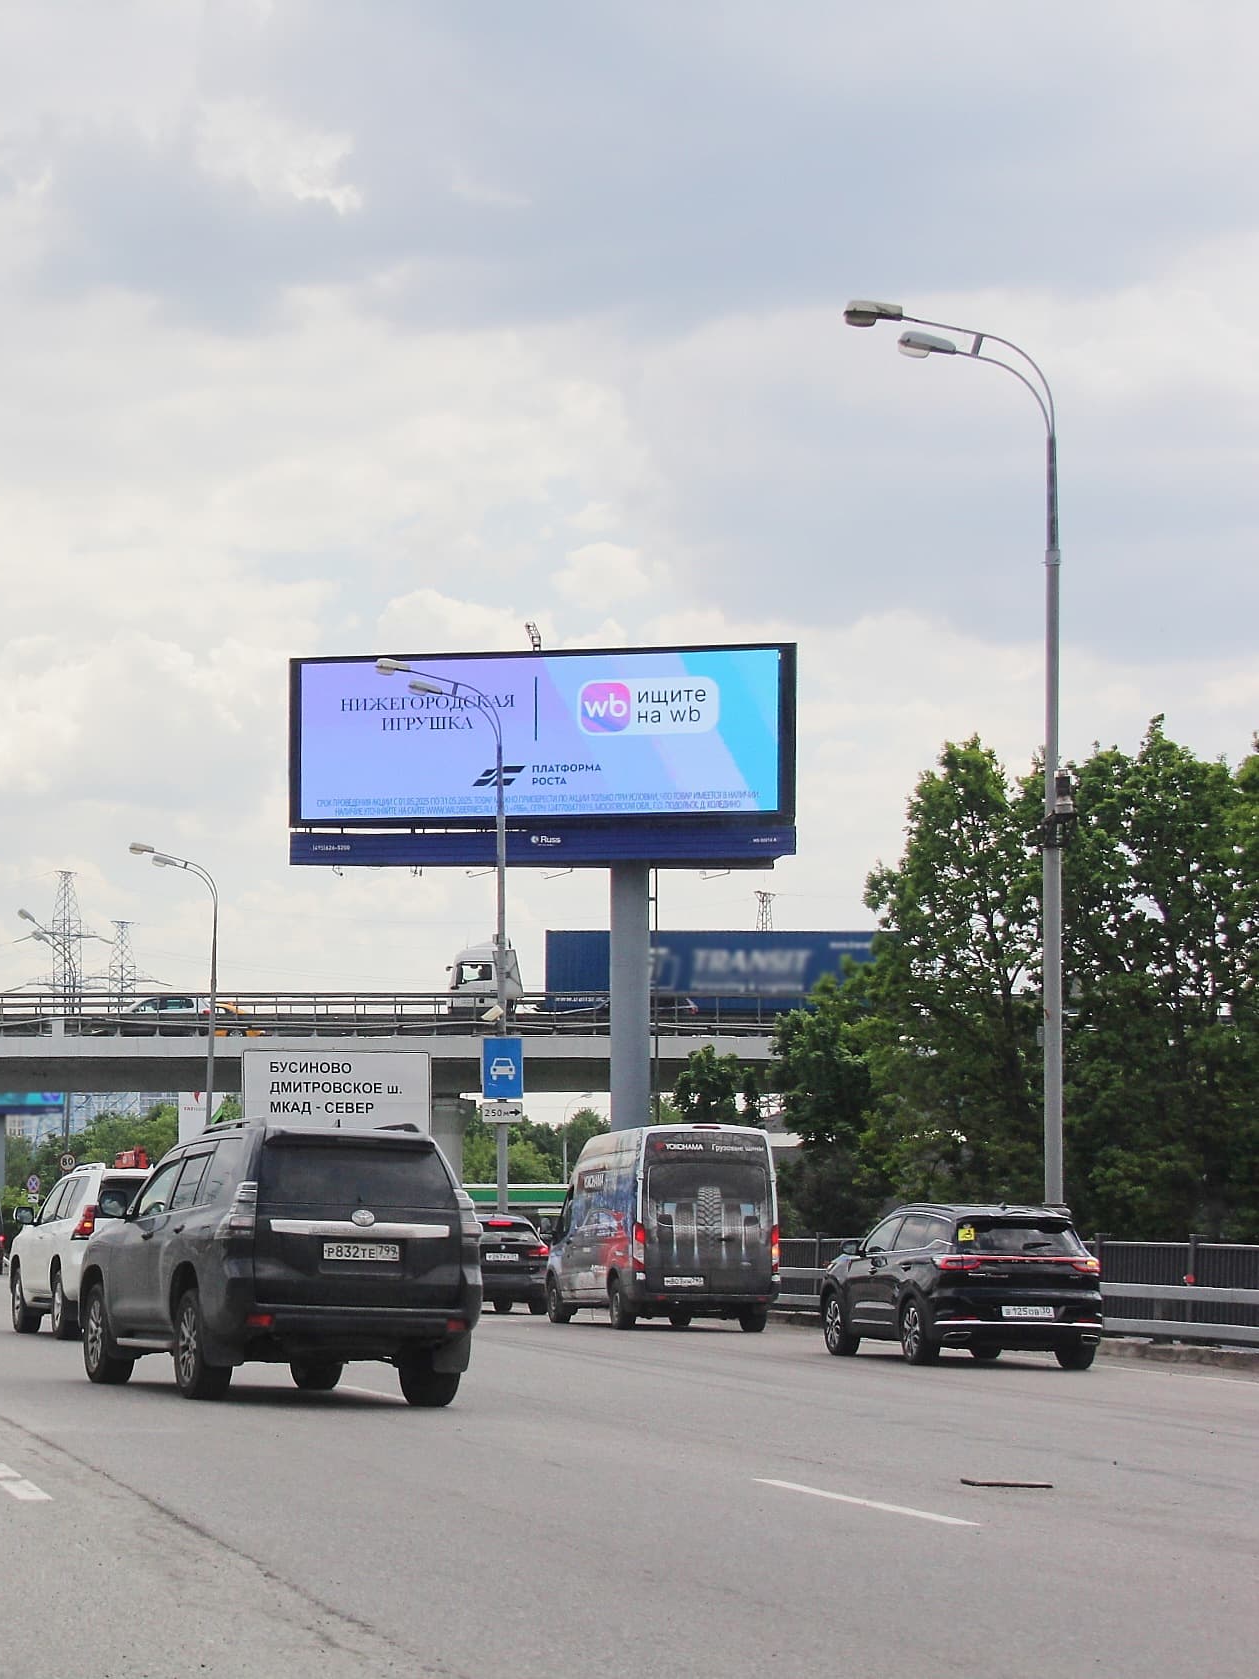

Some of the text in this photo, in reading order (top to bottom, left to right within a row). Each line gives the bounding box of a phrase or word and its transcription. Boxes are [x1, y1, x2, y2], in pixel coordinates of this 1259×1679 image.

[341, 694, 515, 712] НИЖЕГОРОДСКАЯ
[637, 688, 706, 706] ищите
[583, 693, 627, 718] wb
[637, 705, 701, 724] на wb
[381, 716, 473, 731] ИГРУШКА
[532, 763, 602, 773] ПЛАТФОРМА
[532, 777, 567, 786] РОСТА
[540, 835, 561, 843] Russ
[693, 949, 811, 972] TRANSIT
[269, 1061, 352, 1074] БУСИНОВО
[269, 1081, 403, 1095] ДМИТРОВСКОЕ ш.
[269, 1102, 311, 1115] МКАД
[324, 1102, 374, 1114] СЕВЕР
[484, 1109, 502, 1117] 250
[665, 1143, 704, 1151] YOKOHAMA
[711, 1144, 744, 1153] Грузовые
[327, 1245, 397, 1258] Р832ТЕ 799
